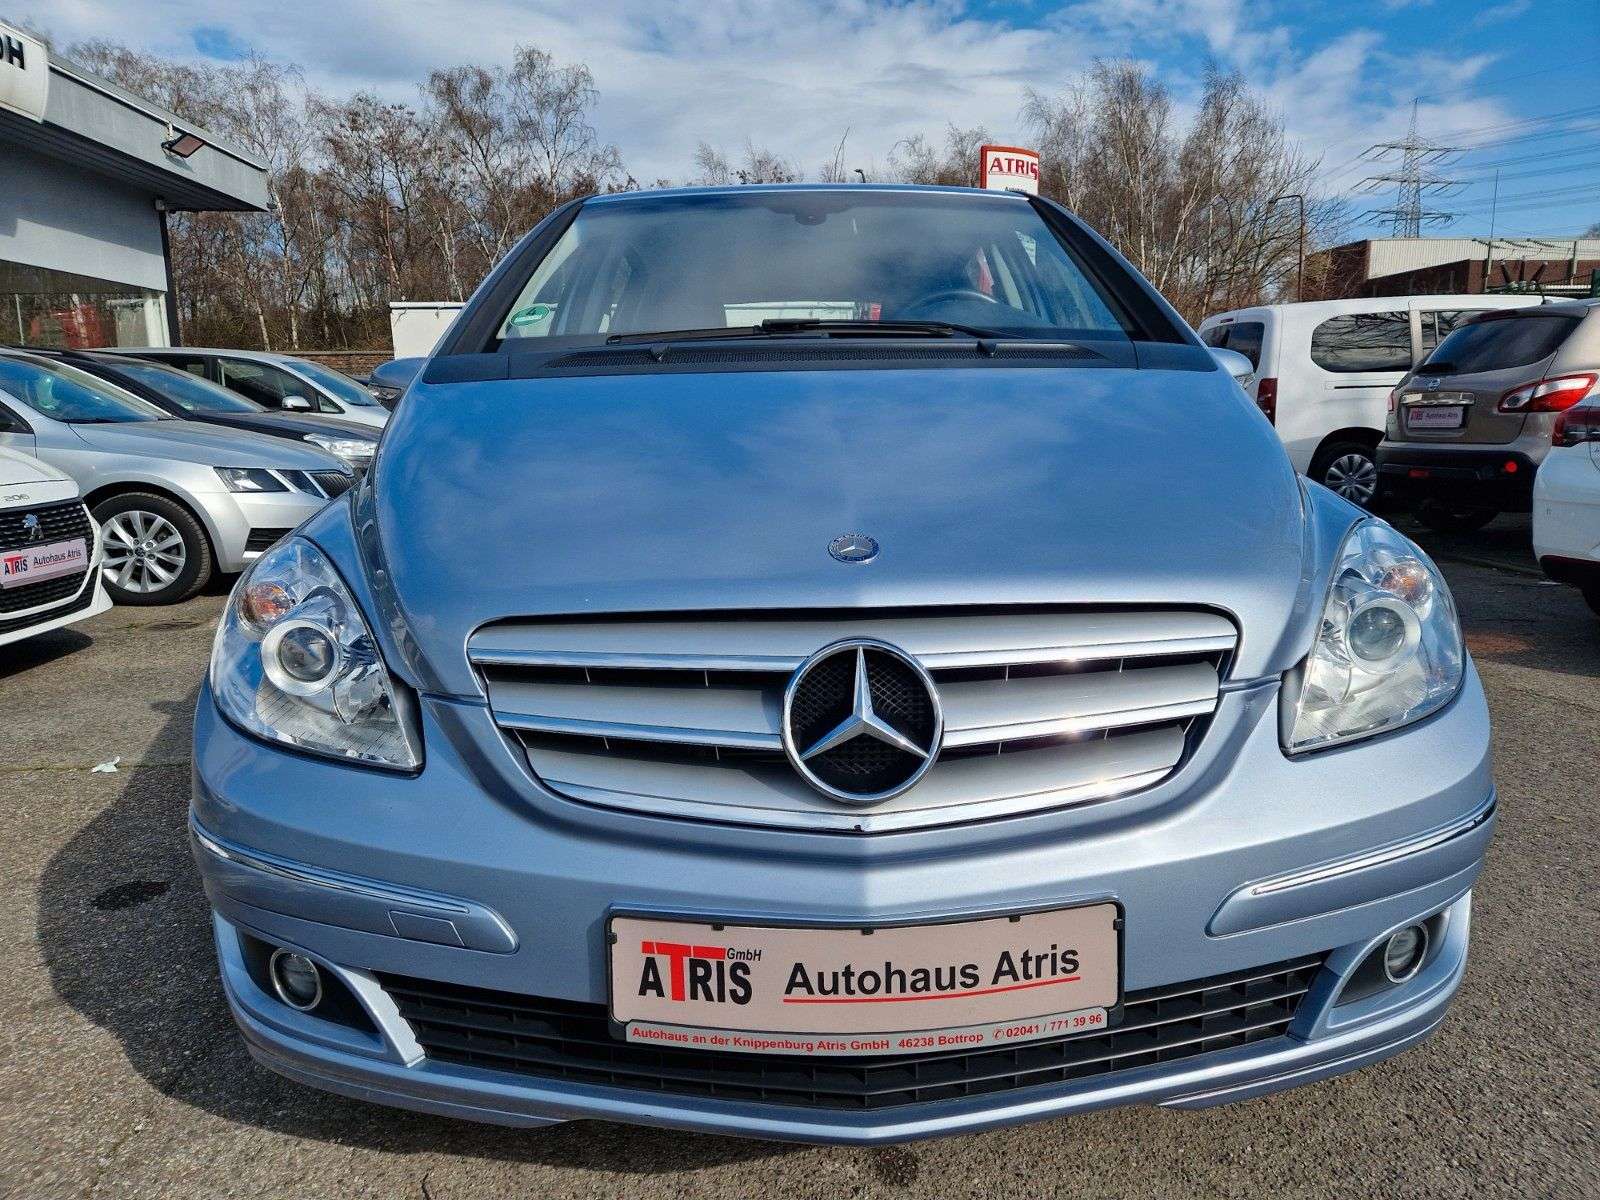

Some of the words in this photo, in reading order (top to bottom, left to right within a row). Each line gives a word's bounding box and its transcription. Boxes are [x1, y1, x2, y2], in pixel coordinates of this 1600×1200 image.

[990, 157, 1038, 180] ATRIS
[4, 555, 28, 575] ATRIS
[33, 552, 65, 566] Autohaus
[67, 548, 81, 558] Atris
[726, 947, 762, 962] GmbH
[638, 941, 753, 1005] ATRIS
[784, 961, 980, 996] Autohaus
[991, 943, 1080, 986] Atris
[632, 1027, 689, 1043] Autohaus
[692, 1035, 707, 1045] an
[710, 1034, 730, 1046] der
[733, 1036, 814, 1052] Knippenburg
[816, 1040, 847, 1051] Atris
[850, 1040, 890, 1050] GmbH
[898, 1036, 935, 1049] 46238
[938, 1032, 984, 1046] Bottrop
[1006, 1024, 1040, 1038] 02041
[1050, 1019, 1069, 1031] 771
[1073, 1016, 1086, 1029] 39
[1089, 1013, 1102, 1025] 96
